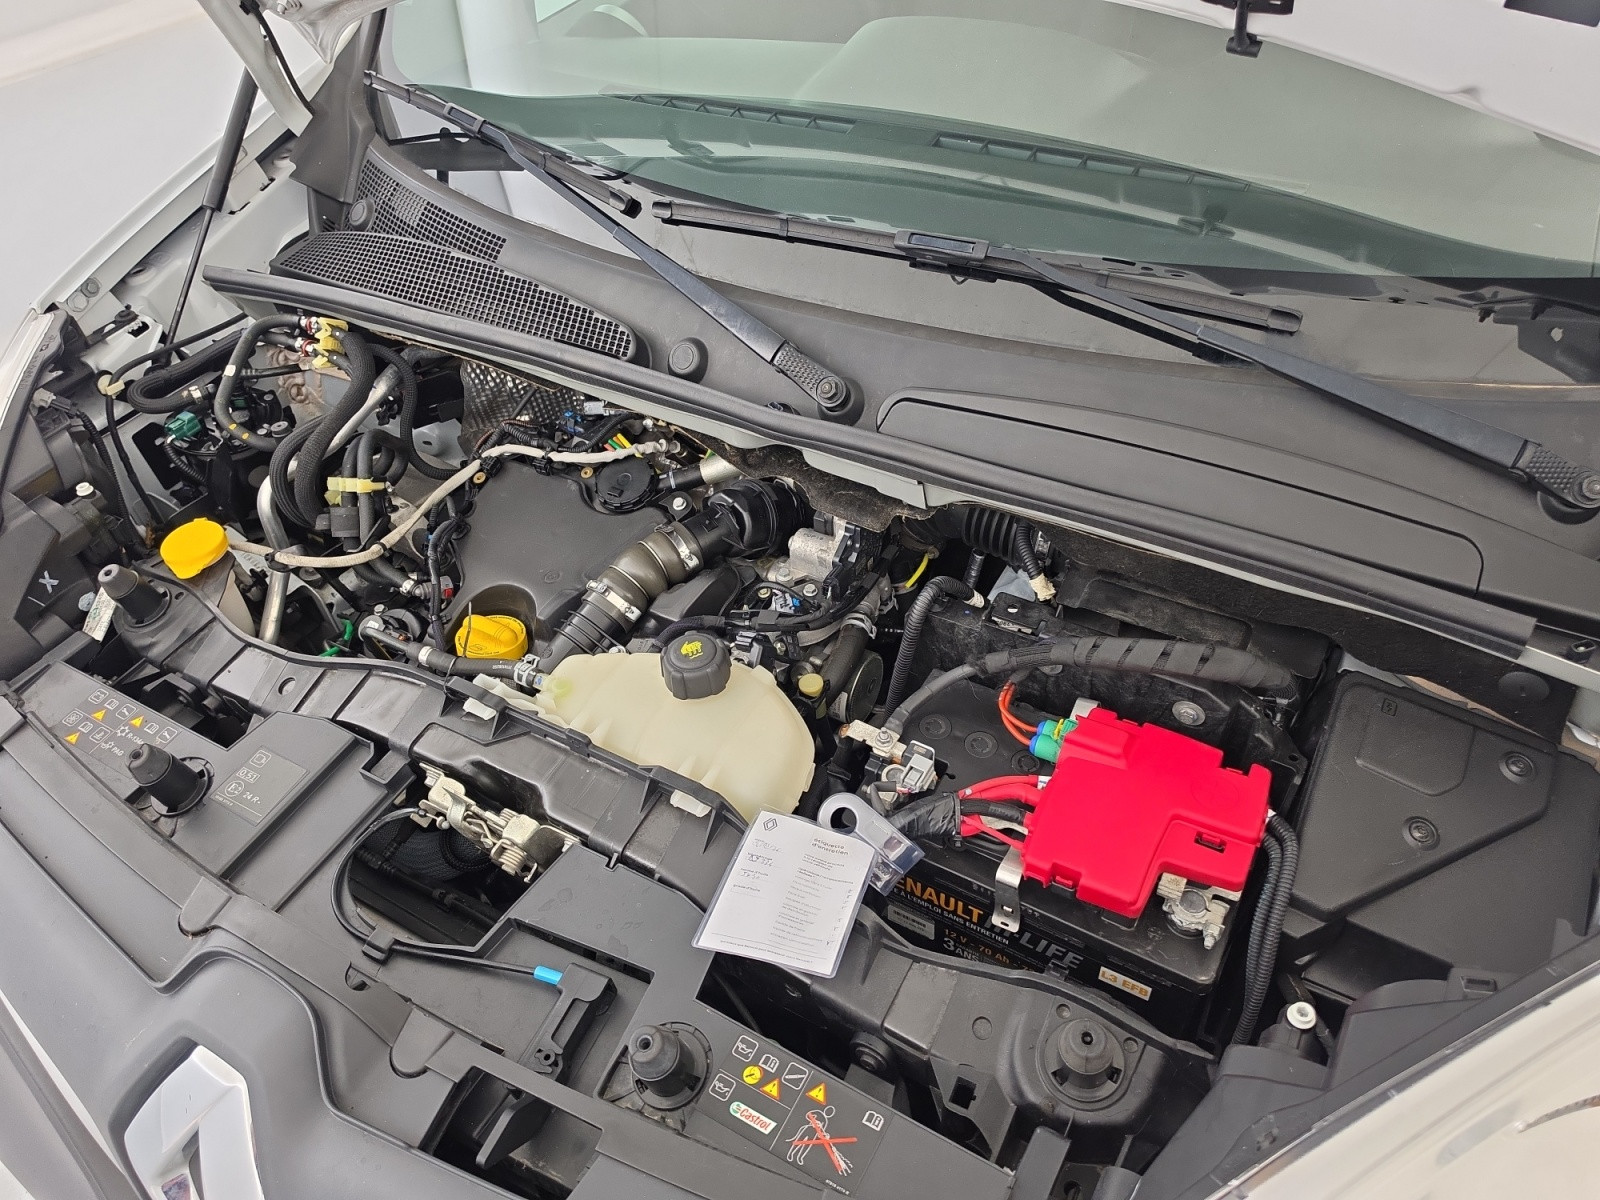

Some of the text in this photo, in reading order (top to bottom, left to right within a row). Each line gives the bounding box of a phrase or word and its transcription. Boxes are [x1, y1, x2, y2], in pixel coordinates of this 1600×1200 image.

[894, 876, 984, 924] ENAULT
[907, 892, 942, 915] L'EMPLOI
[943, 909, 964, 925] SANS
[966, 920, 1010, 945] ENTRETIEN
[942, 937, 955, 951] 3
[944, 928, 957, 939] 12
[960, 935, 967, 944] V
[978, 944, 992, 956] 70
[995, 952, 1010, 965] Ah
[1101, 970, 1149, 997] L3 EFB
[739, 1107, 771, 1133] Castrol
